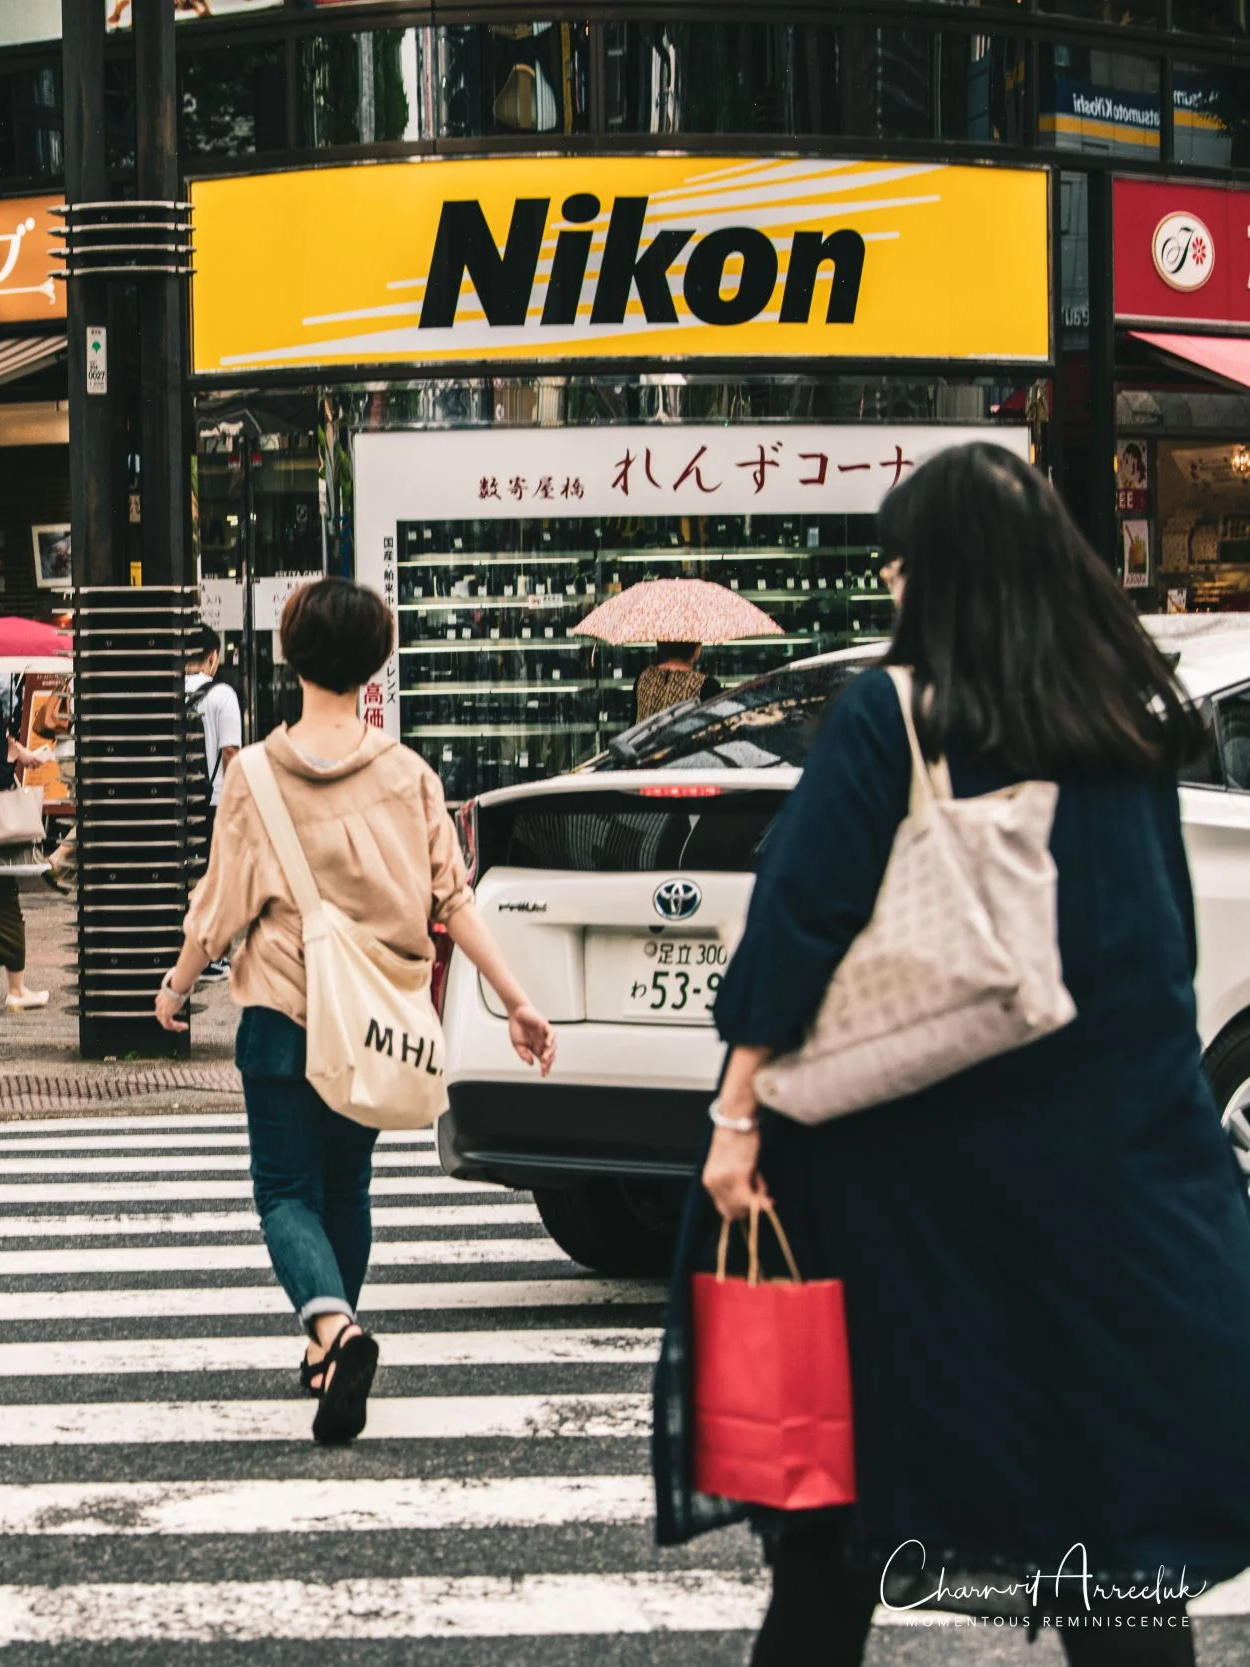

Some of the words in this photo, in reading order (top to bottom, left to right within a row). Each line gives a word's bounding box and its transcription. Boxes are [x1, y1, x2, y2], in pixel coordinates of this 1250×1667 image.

[418, 192, 866, 329] Nikon
[478, 476, 585, 501] 数寄屋橋
[657, 942, 692, 965] 足立
[696, 943, 728, 965] 300
[631, 980, 647, 999] わ
